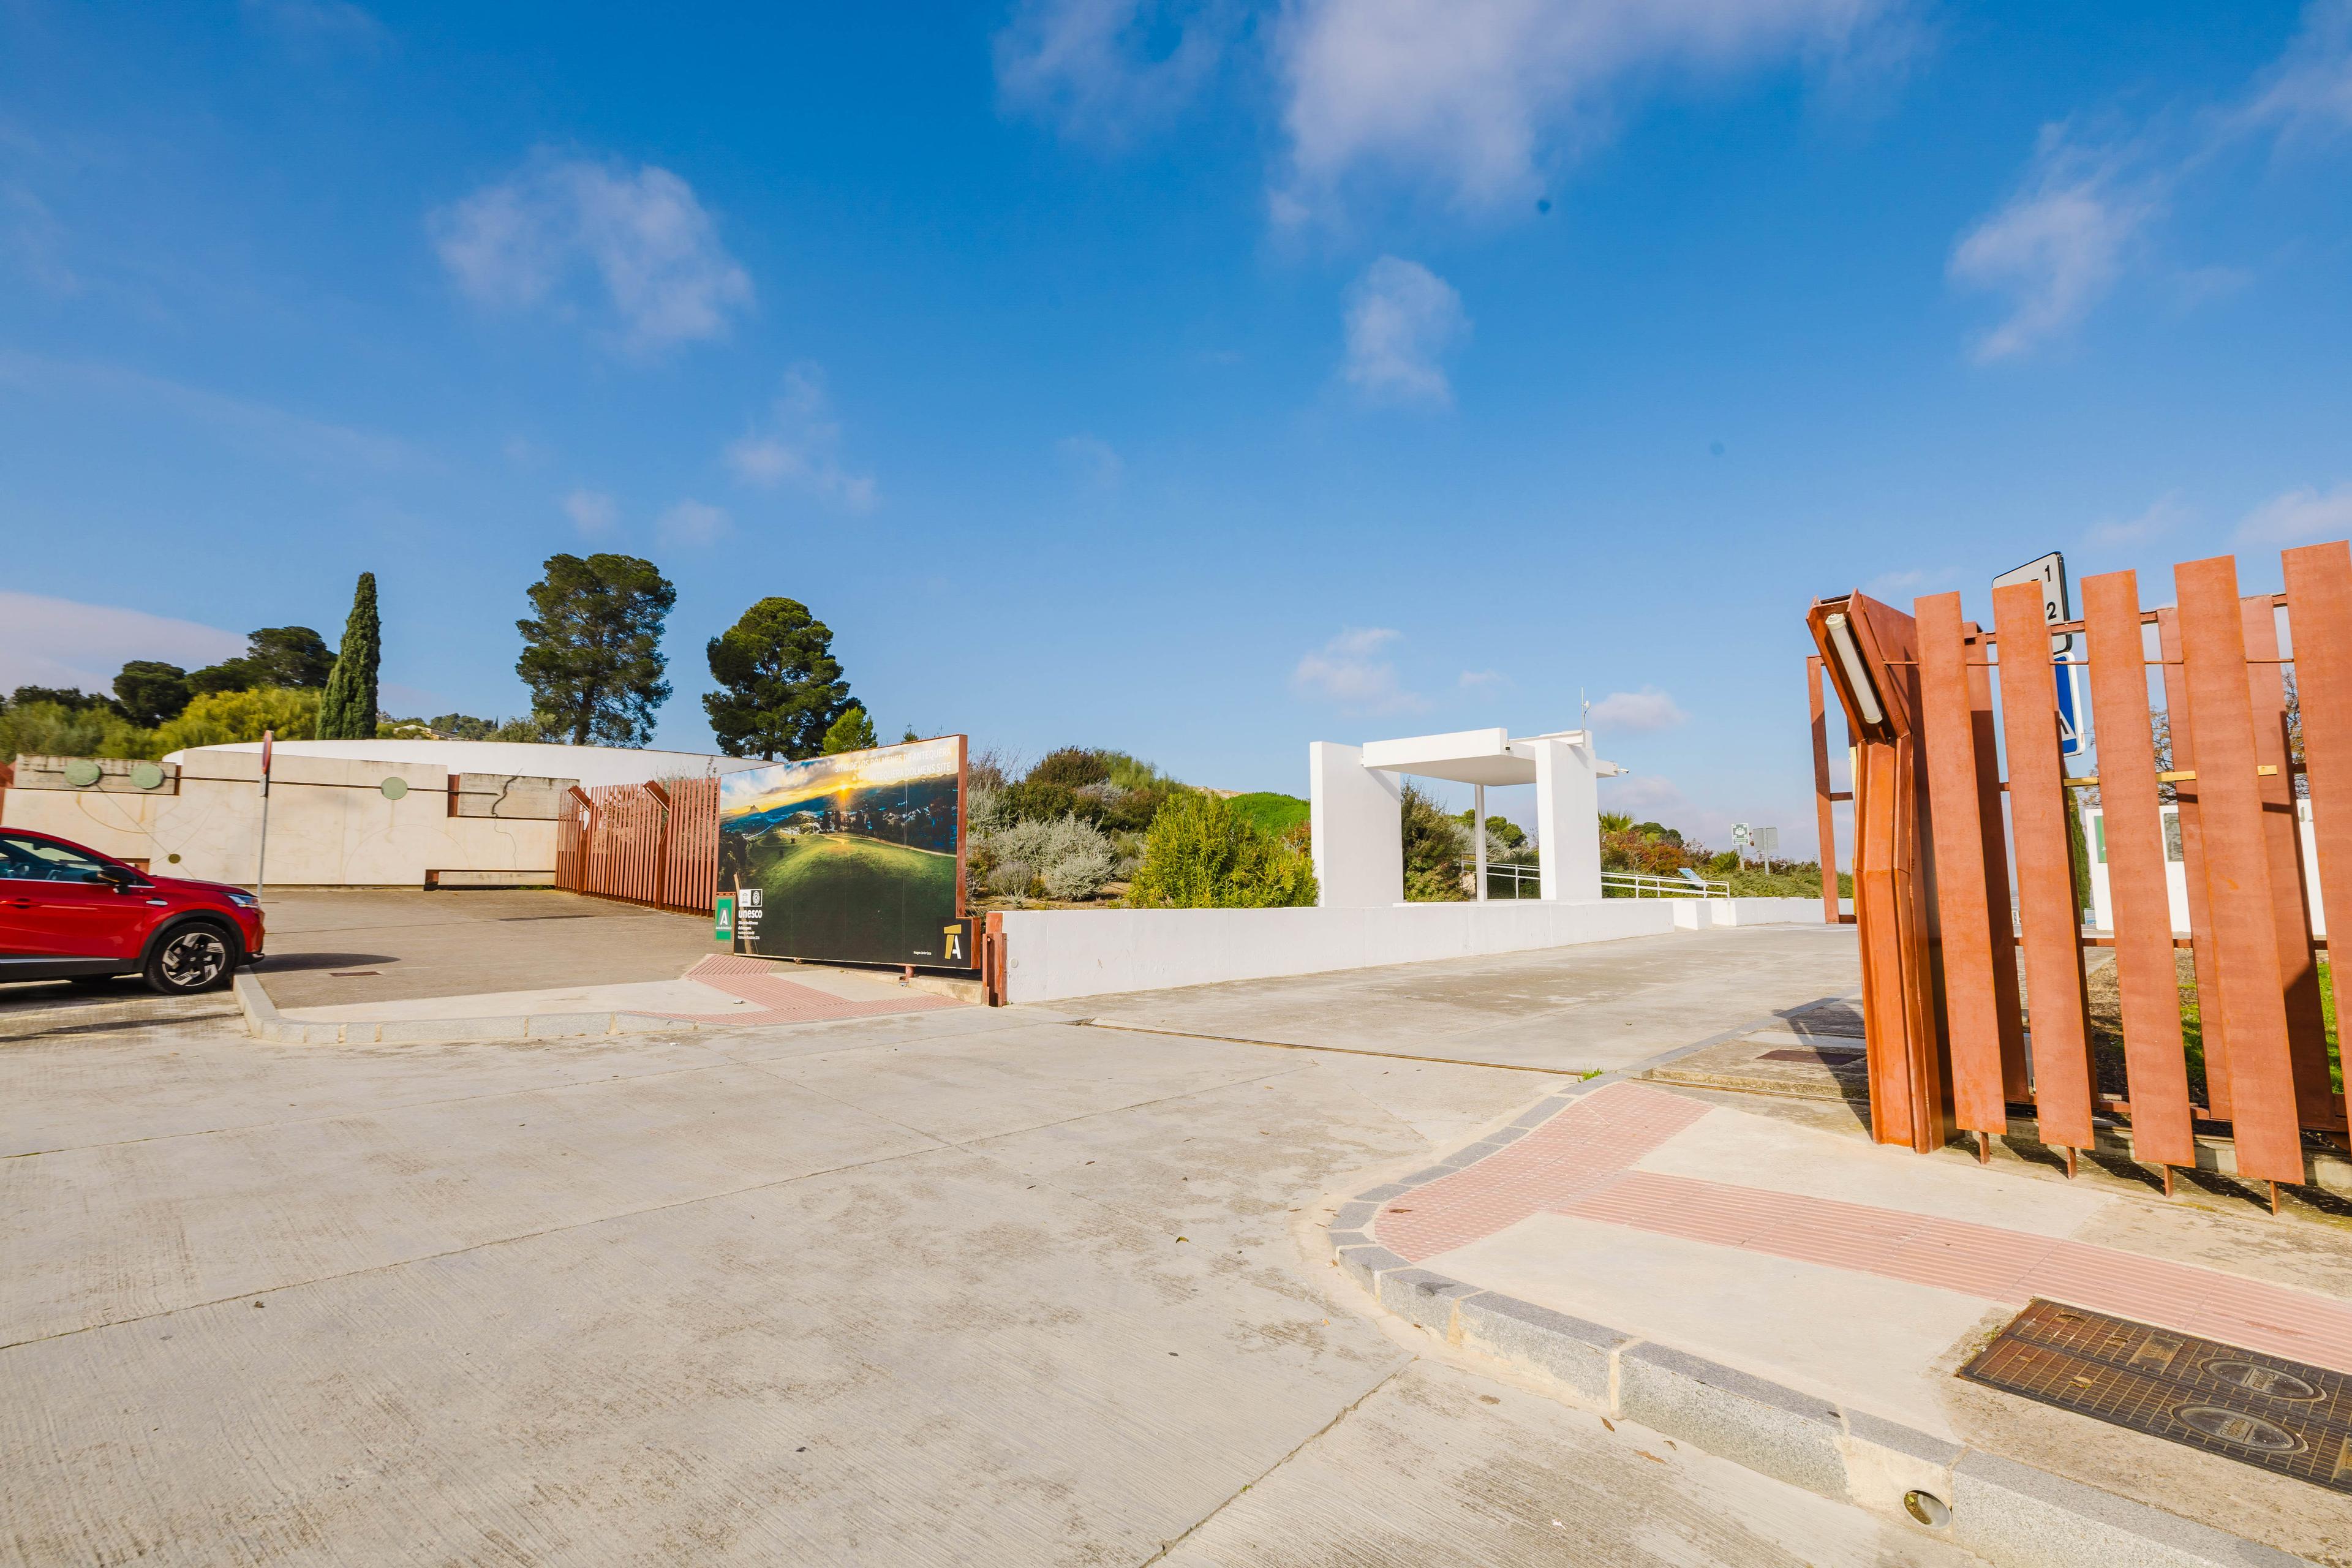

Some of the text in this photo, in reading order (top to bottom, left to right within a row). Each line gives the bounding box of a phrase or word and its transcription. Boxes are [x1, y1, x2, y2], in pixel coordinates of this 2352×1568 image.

[2045, 565, 2051, 582] 1
[2046, 601, 2057, 620] 2
[738, 910, 763, 918] unesco
